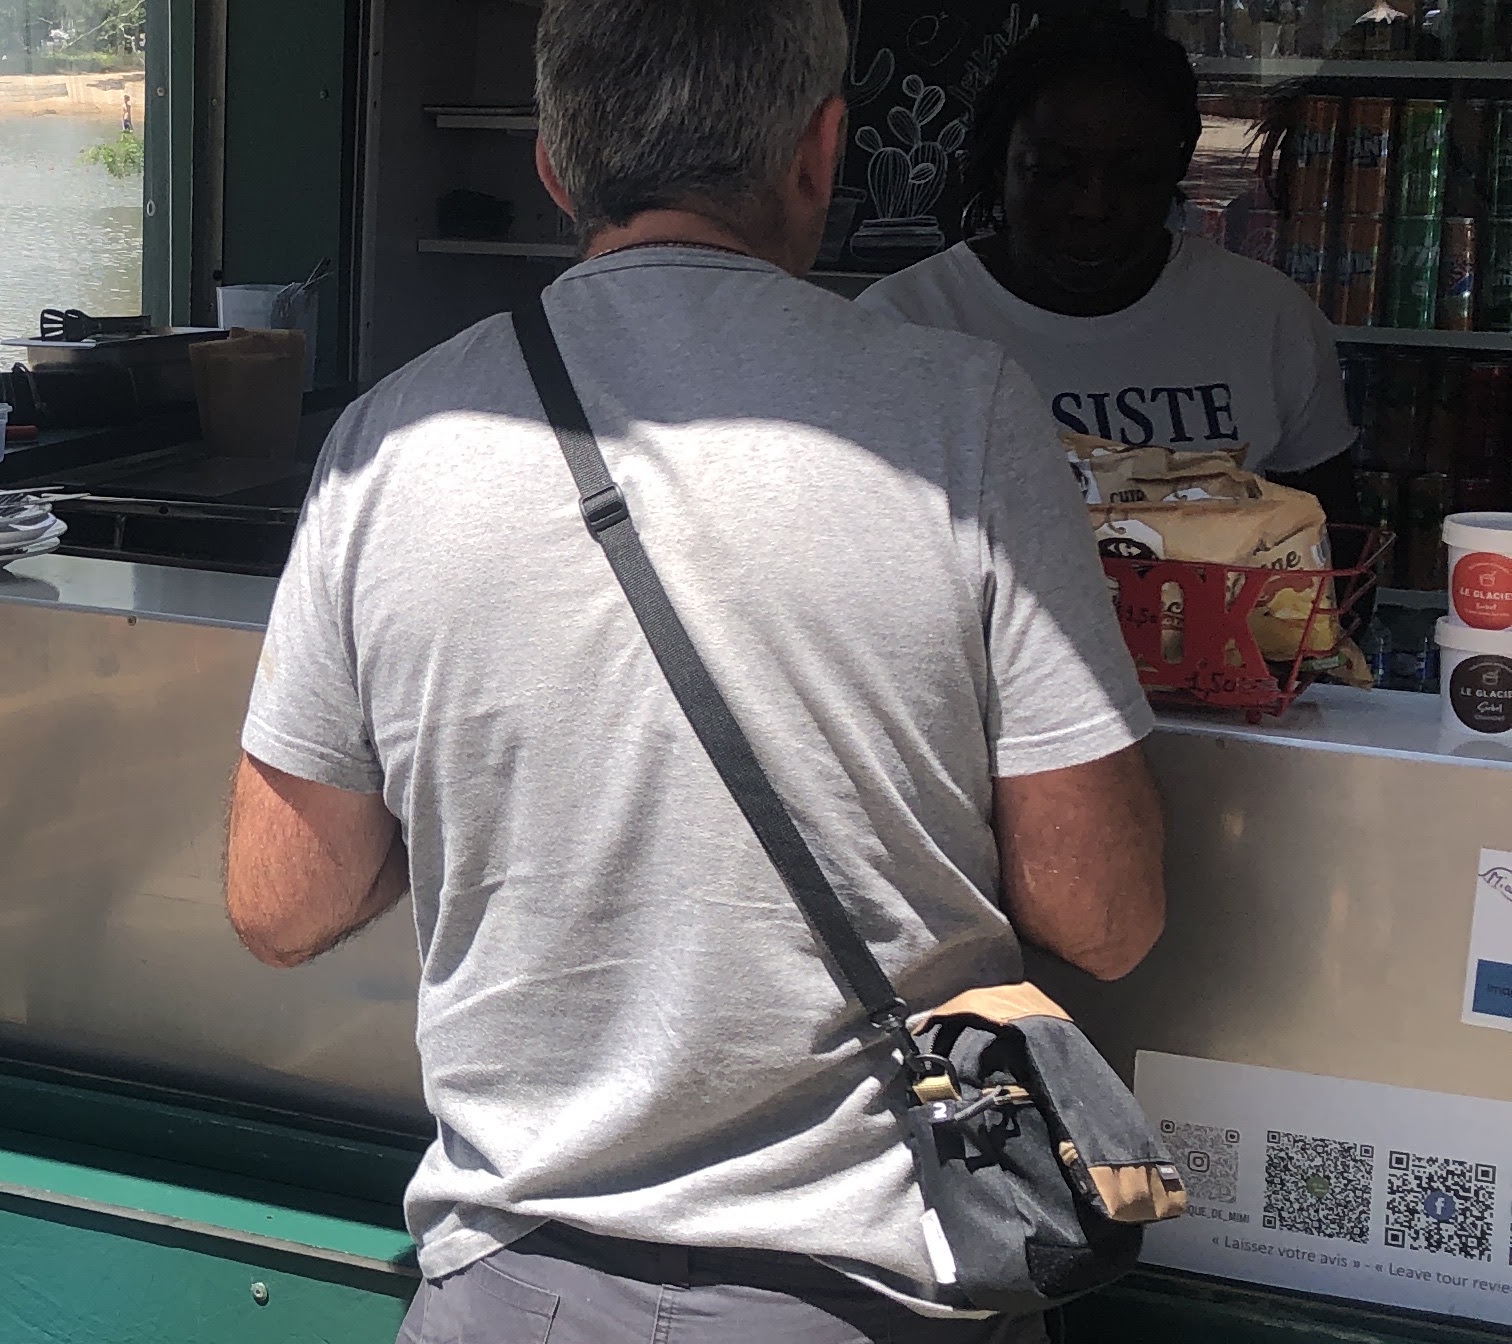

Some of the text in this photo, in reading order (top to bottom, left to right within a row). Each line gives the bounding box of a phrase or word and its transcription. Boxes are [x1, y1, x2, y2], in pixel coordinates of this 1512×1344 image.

[1459, 586, 1470, 596] LE
[1460, 686, 1472, 696] LE
[1224, 1235, 1274, 1254] Laissez
[1277, 1247, 1316, 1263] votre
[1320, 1252, 1348, 1268] avis
[1389, 1265, 1432, 1282] Leave
[1436, 1271, 1469, 1288] tour
[1472, 1277, 1512, 1294] revie
